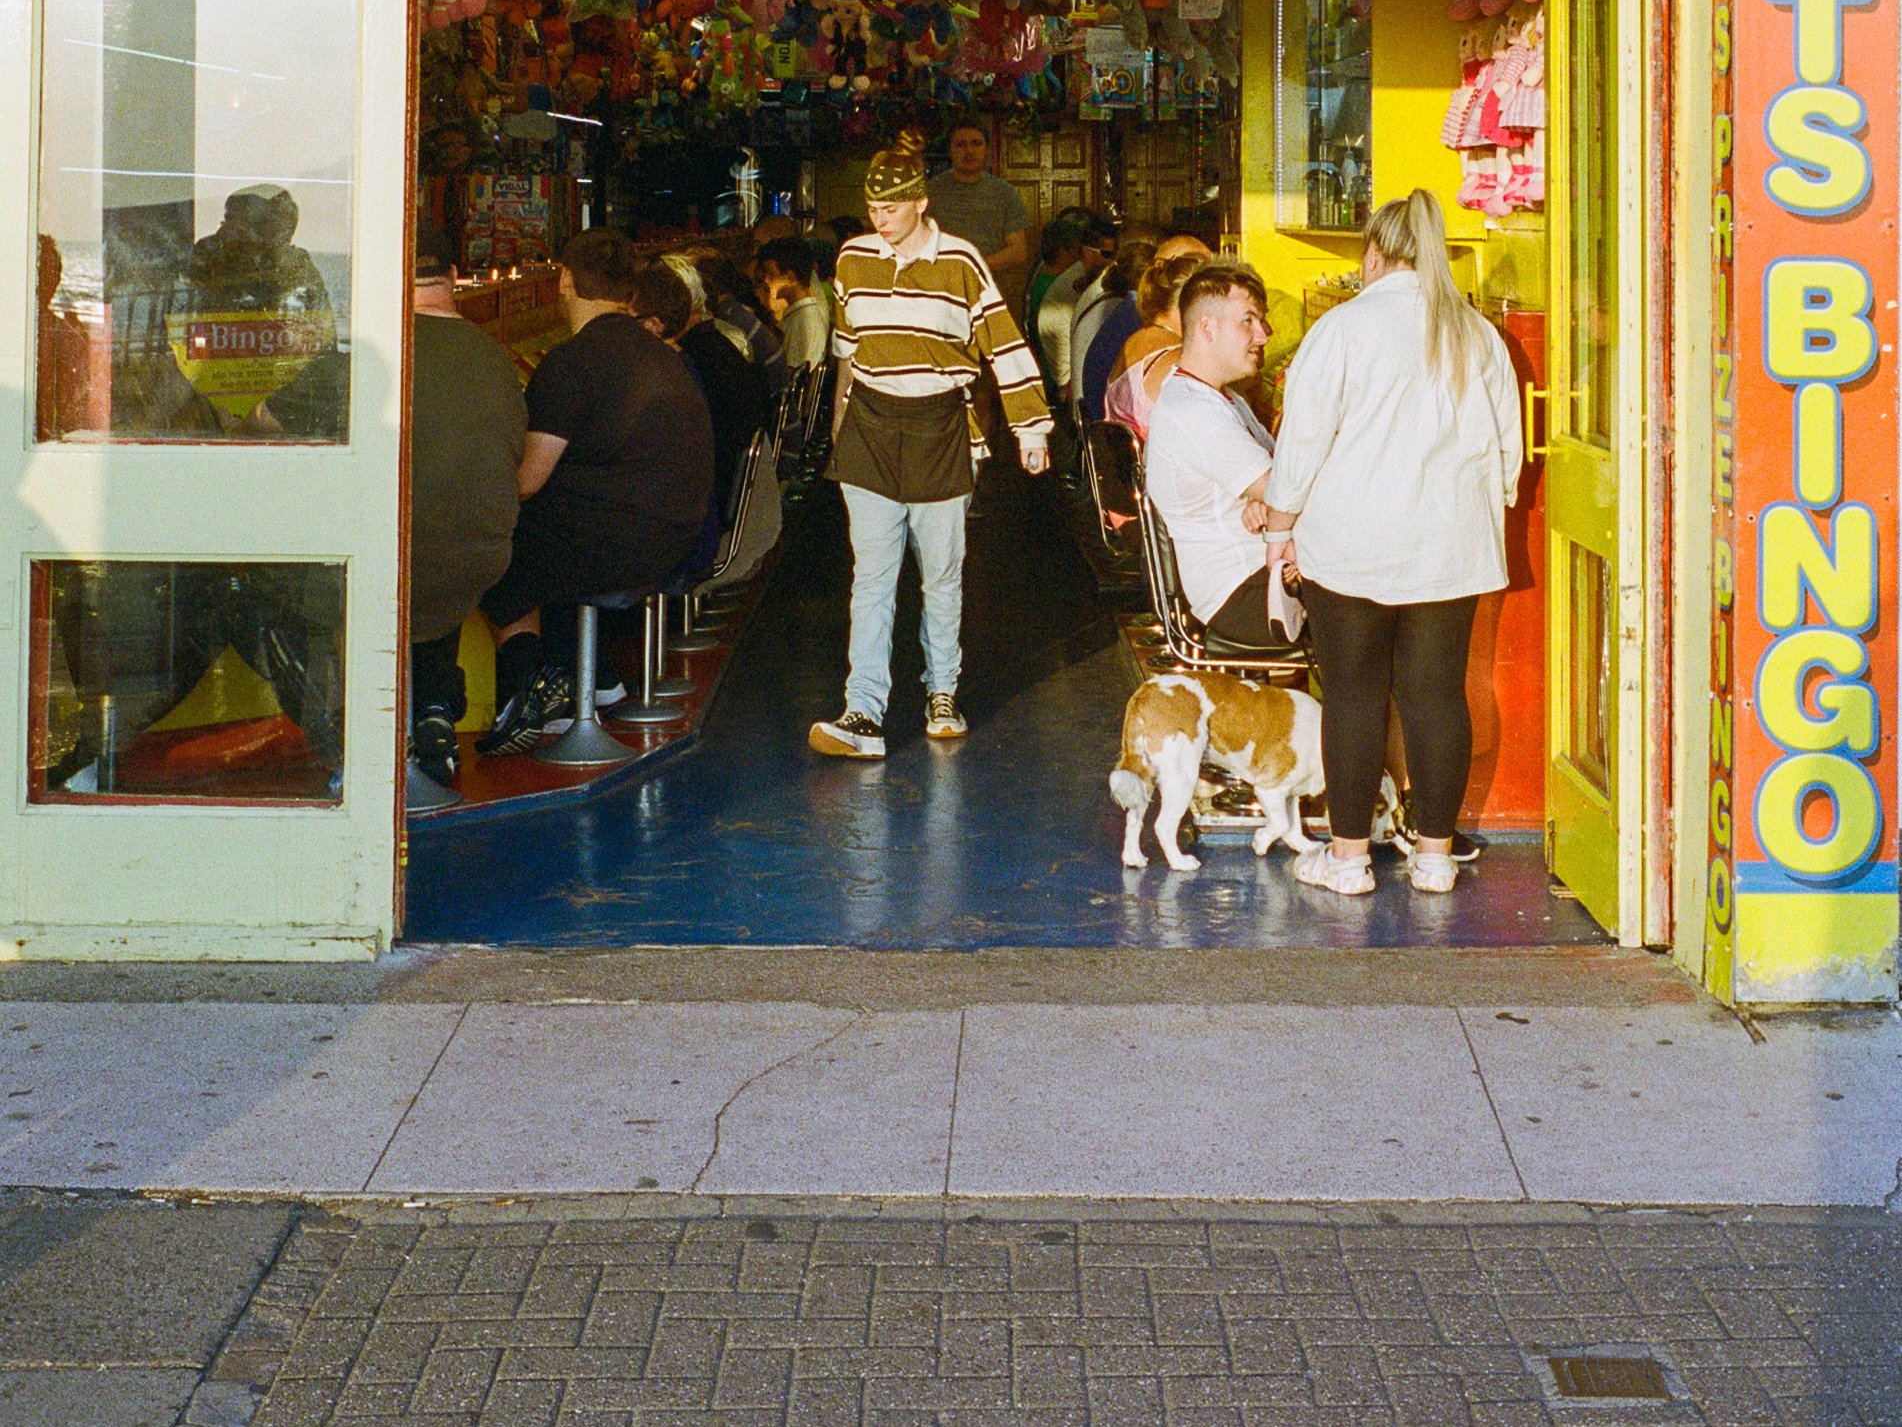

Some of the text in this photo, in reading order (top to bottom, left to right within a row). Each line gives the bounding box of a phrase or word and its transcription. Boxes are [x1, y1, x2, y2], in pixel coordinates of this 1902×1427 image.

[212, 323, 295, 355] Bingo
[498, 180, 528, 191] VIDAL
[1714, 113, 1733, 505] PRIZE
[1709, 537, 1733, 933] BINGO
[1757, 259, 1882, 875] BINGO
